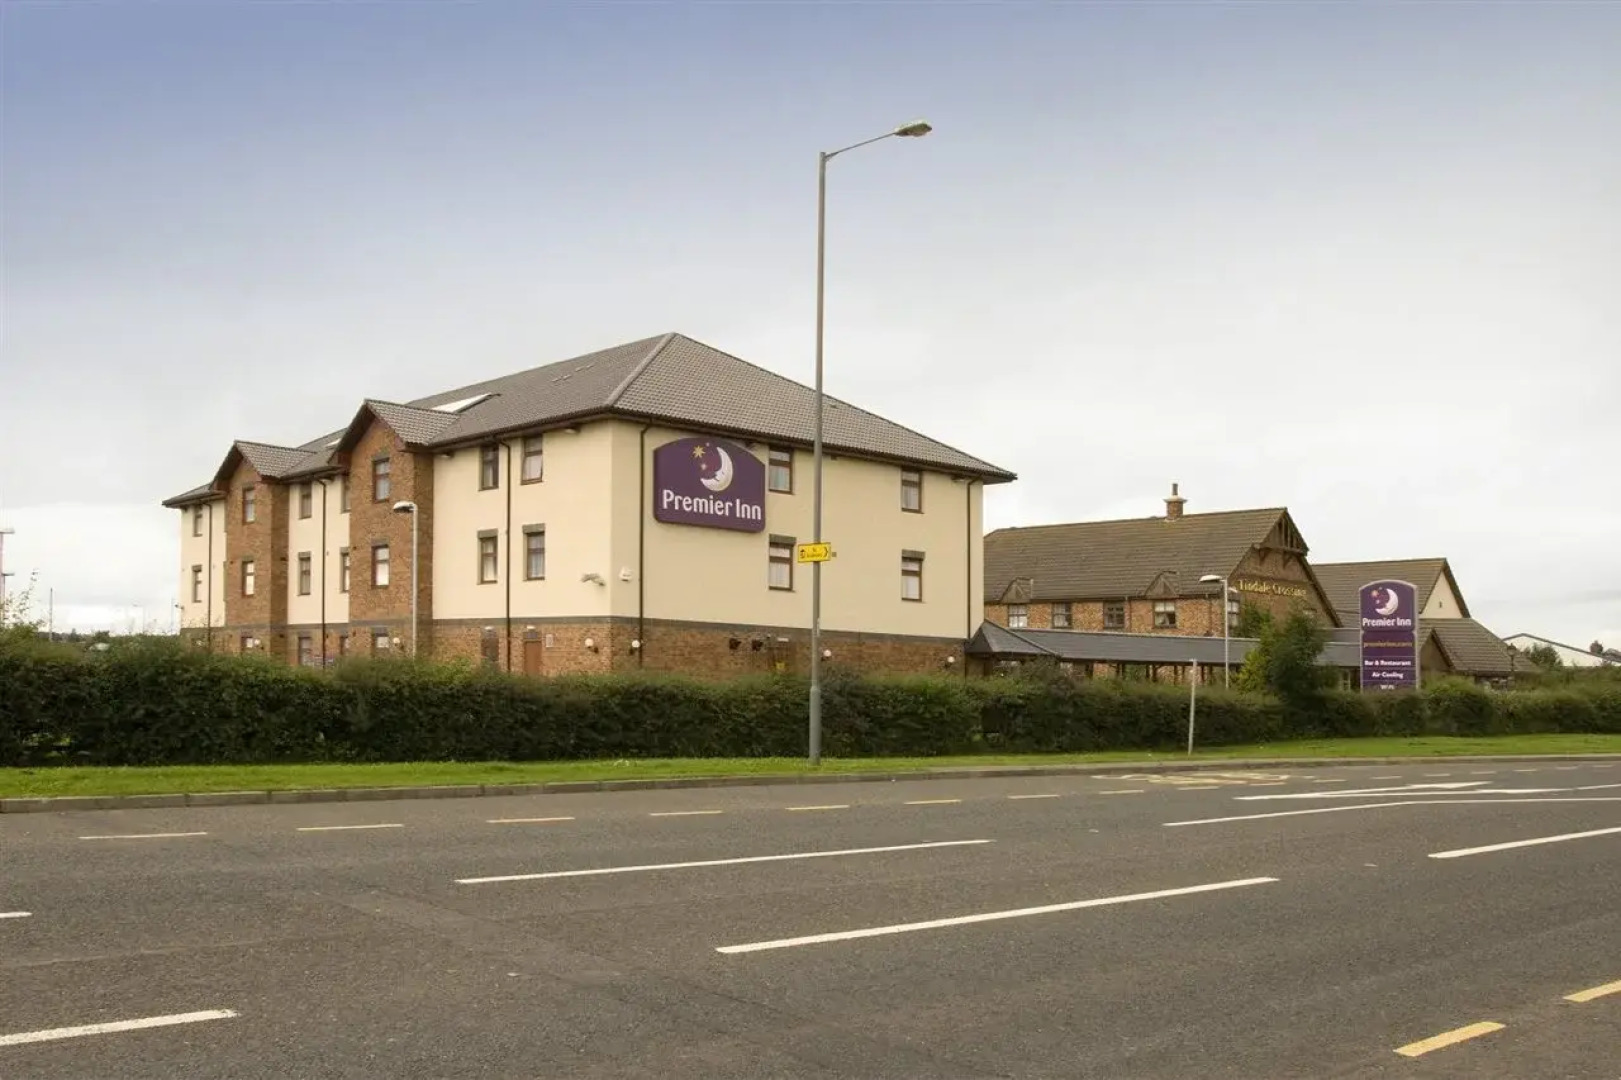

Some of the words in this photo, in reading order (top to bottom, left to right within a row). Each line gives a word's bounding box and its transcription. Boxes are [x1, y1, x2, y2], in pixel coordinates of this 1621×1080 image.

[662, 489, 733, 516] Premier
[735, 498, 762, 520] Inn
[1362, 617, 1396, 627] Premier
[1396, 617, 1412, 627] Inn
